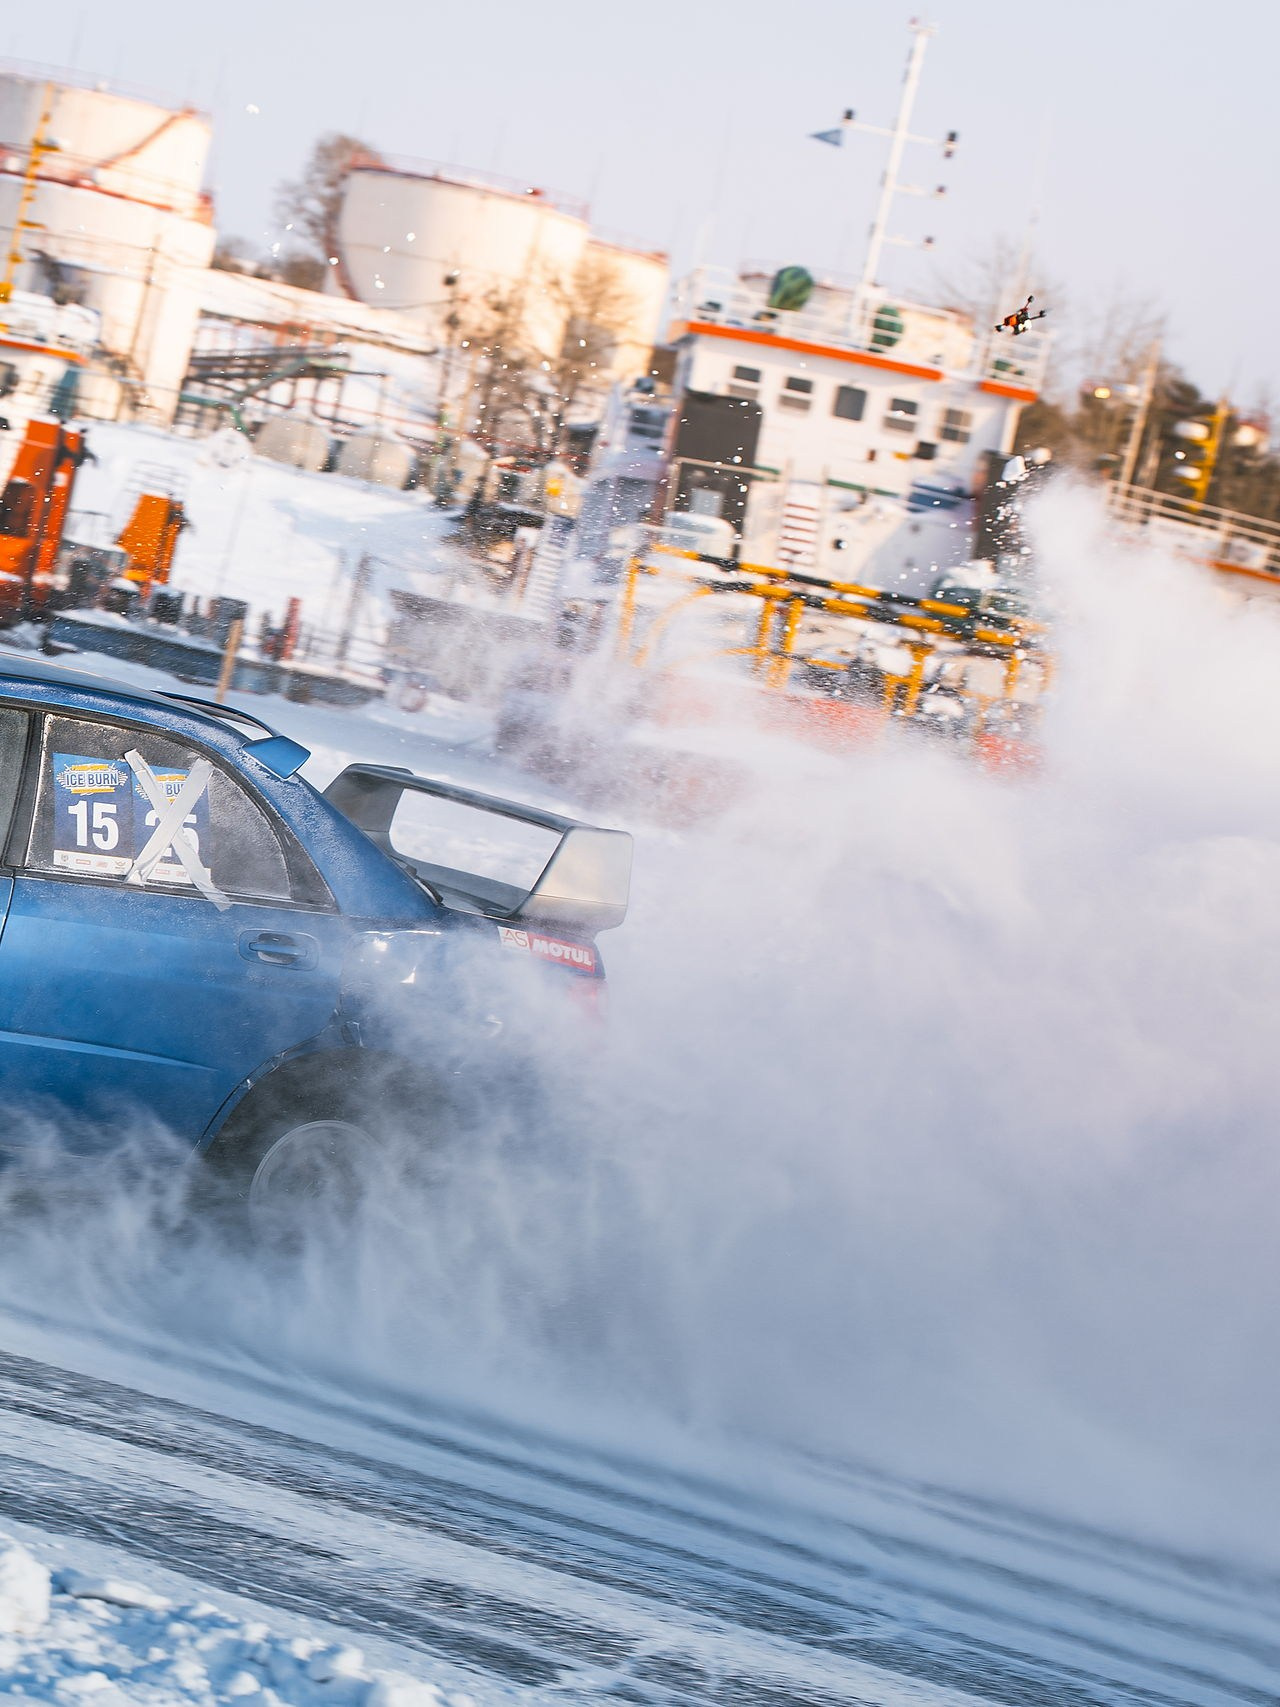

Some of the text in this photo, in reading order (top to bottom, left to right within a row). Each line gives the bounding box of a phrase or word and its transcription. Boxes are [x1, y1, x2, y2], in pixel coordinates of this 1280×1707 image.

[66, 772, 118, 786] ICE BURN
[165, 782, 186, 796] BU
[67, 800, 120, 851] 15
[531, 938, 593, 967] MOTUL
